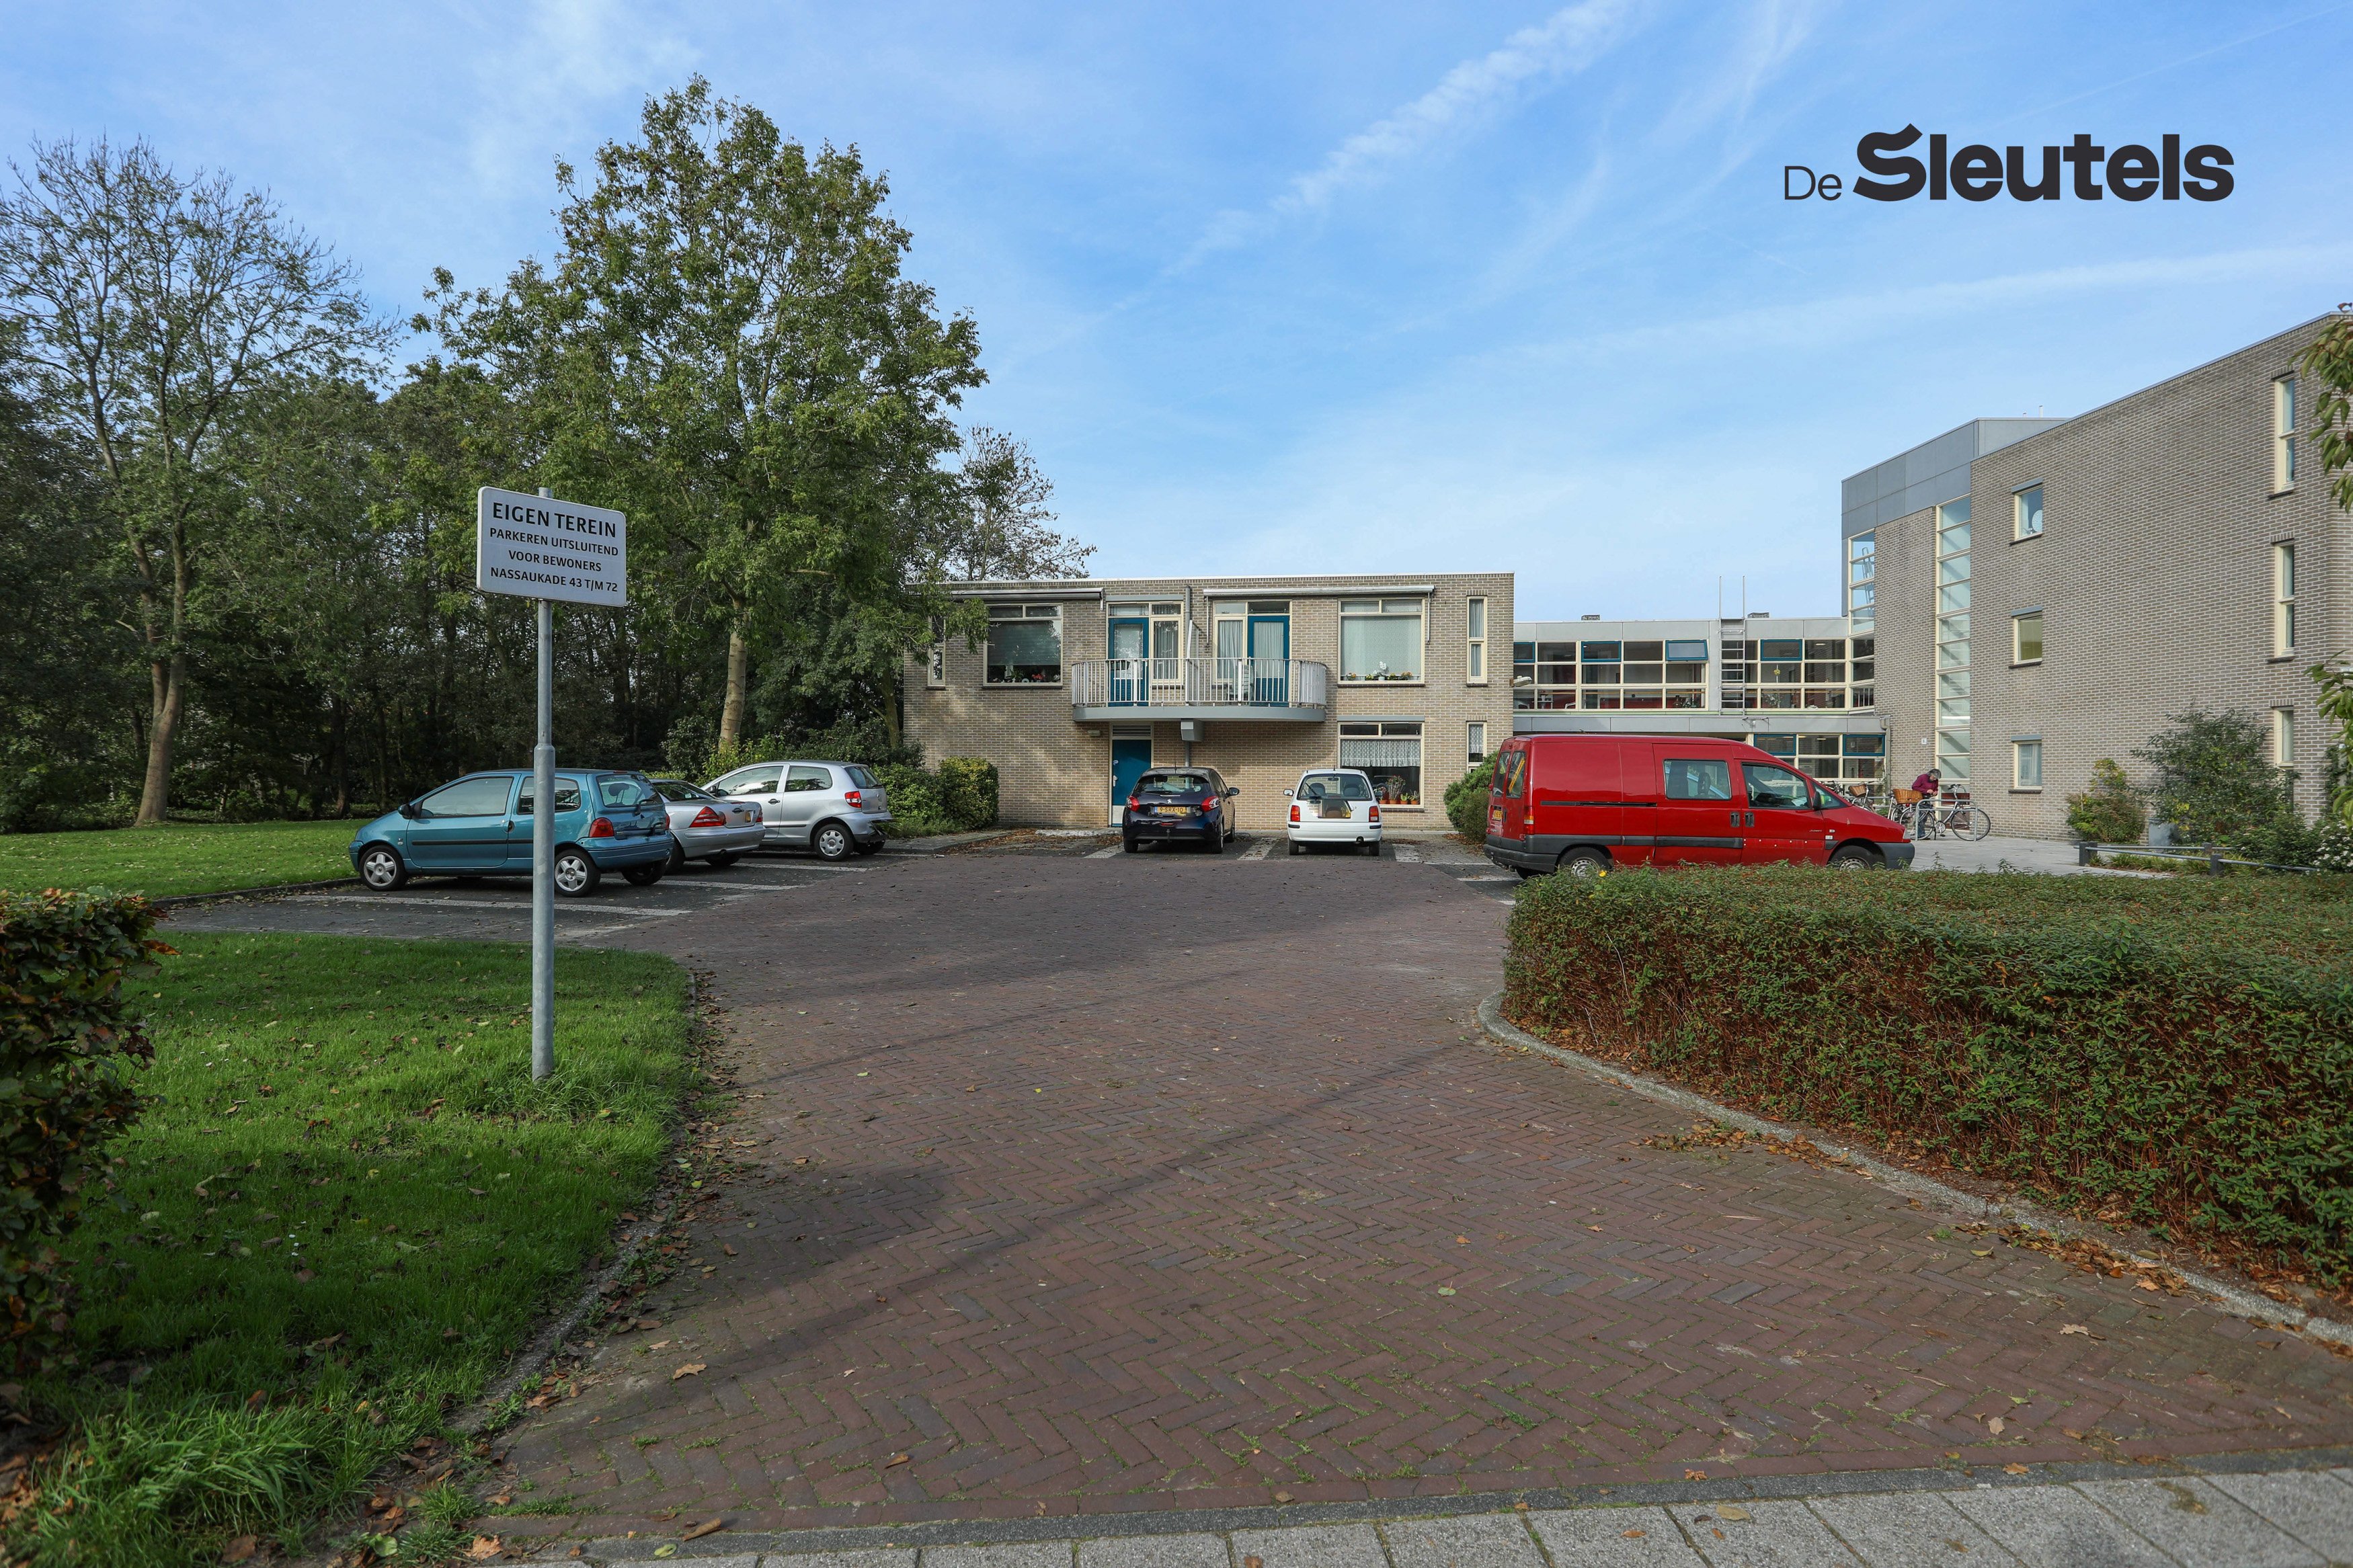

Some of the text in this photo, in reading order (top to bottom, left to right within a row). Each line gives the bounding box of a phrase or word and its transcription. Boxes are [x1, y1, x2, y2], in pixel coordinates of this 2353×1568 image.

[493, 502, 616, 538] EIGEN TEREIN
[490, 528, 619, 556] PARKEREN UITSLUITEND
[508, 550, 602, 572] VOOR BEWONERS
[491, 567, 618, 592] NASSAUKADE 43 T/M 72
